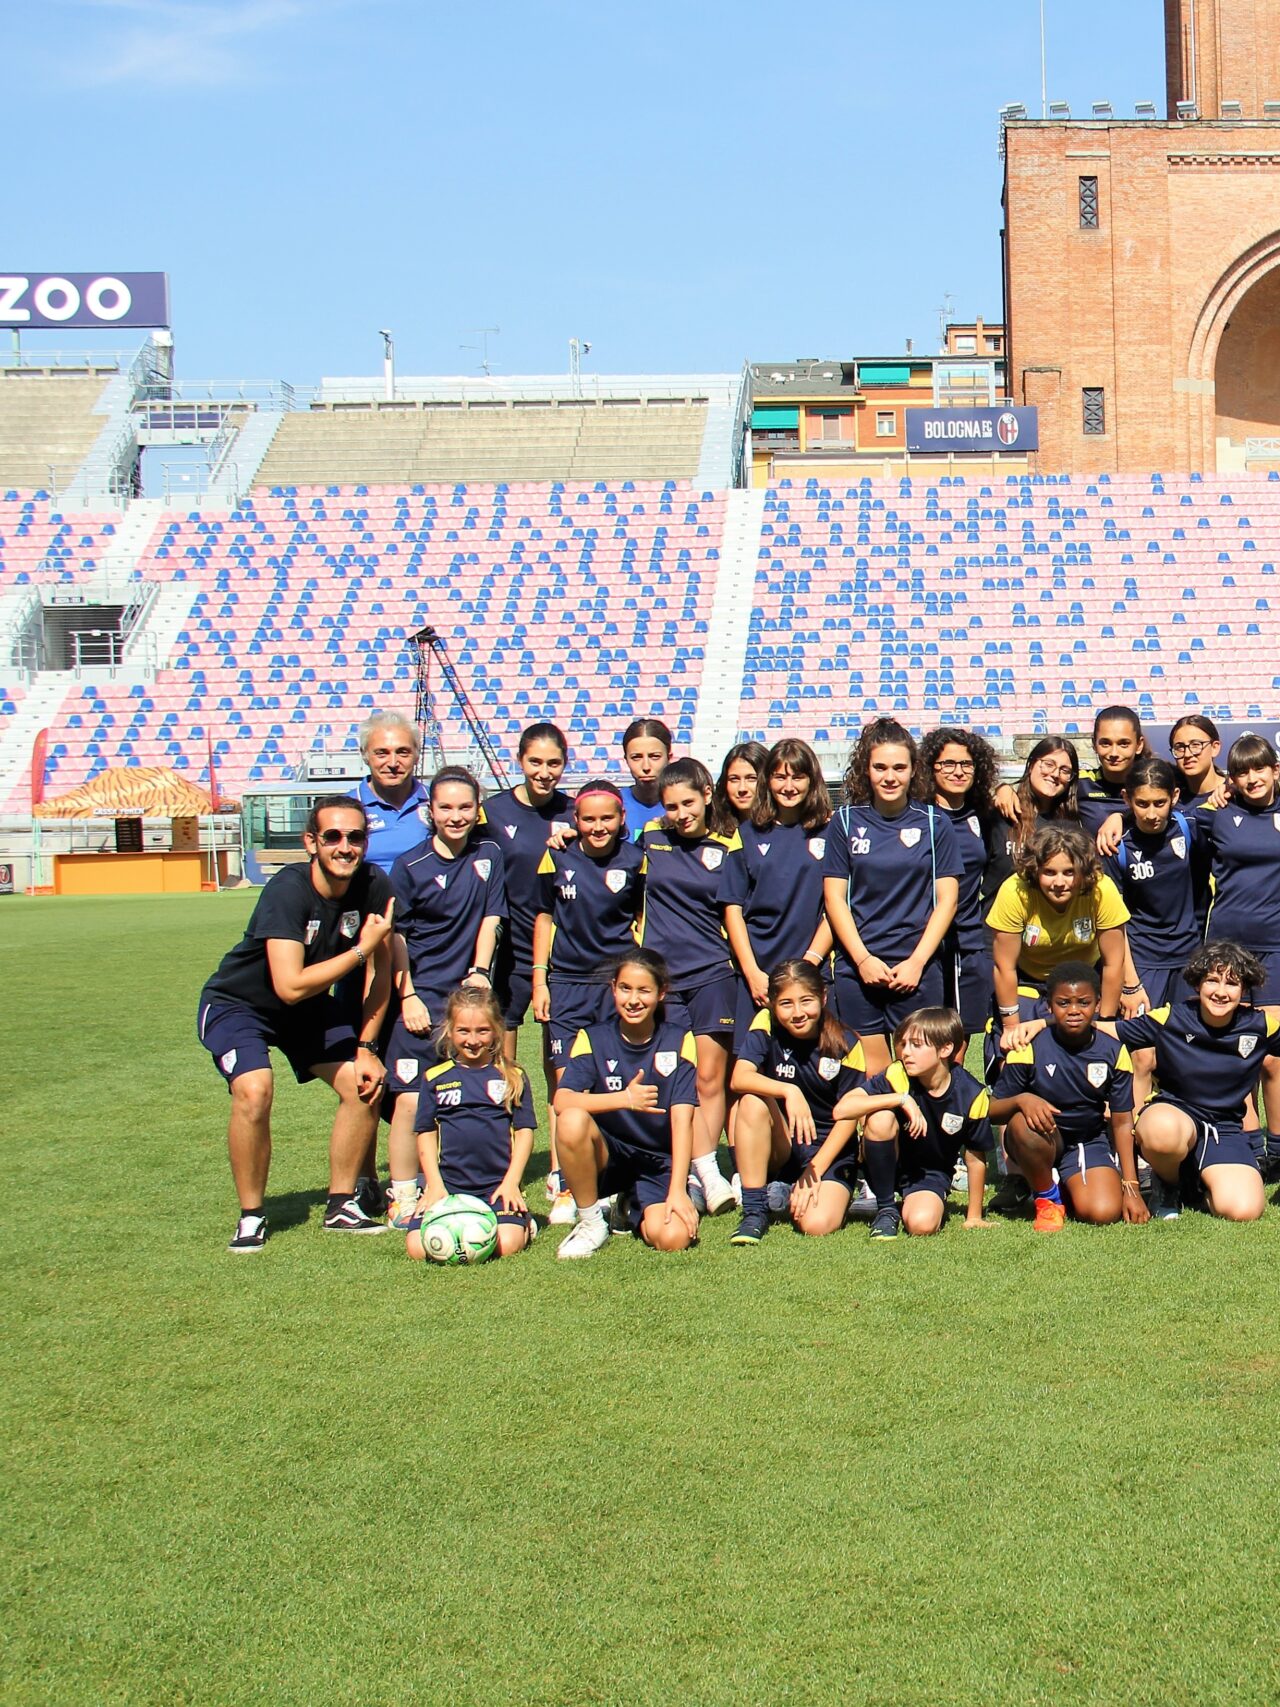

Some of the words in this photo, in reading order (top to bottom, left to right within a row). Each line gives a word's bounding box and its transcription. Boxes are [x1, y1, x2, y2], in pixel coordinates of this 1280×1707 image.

[0, 277, 131, 321] ZOO
[925, 421, 981, 438] BOLOGNA
[851, 836, 871, 854] 218
[1129, 860, 1154, 880] 306
[561, 884, 577, 900] 144
[776, 1063, 796, 1079] 449
